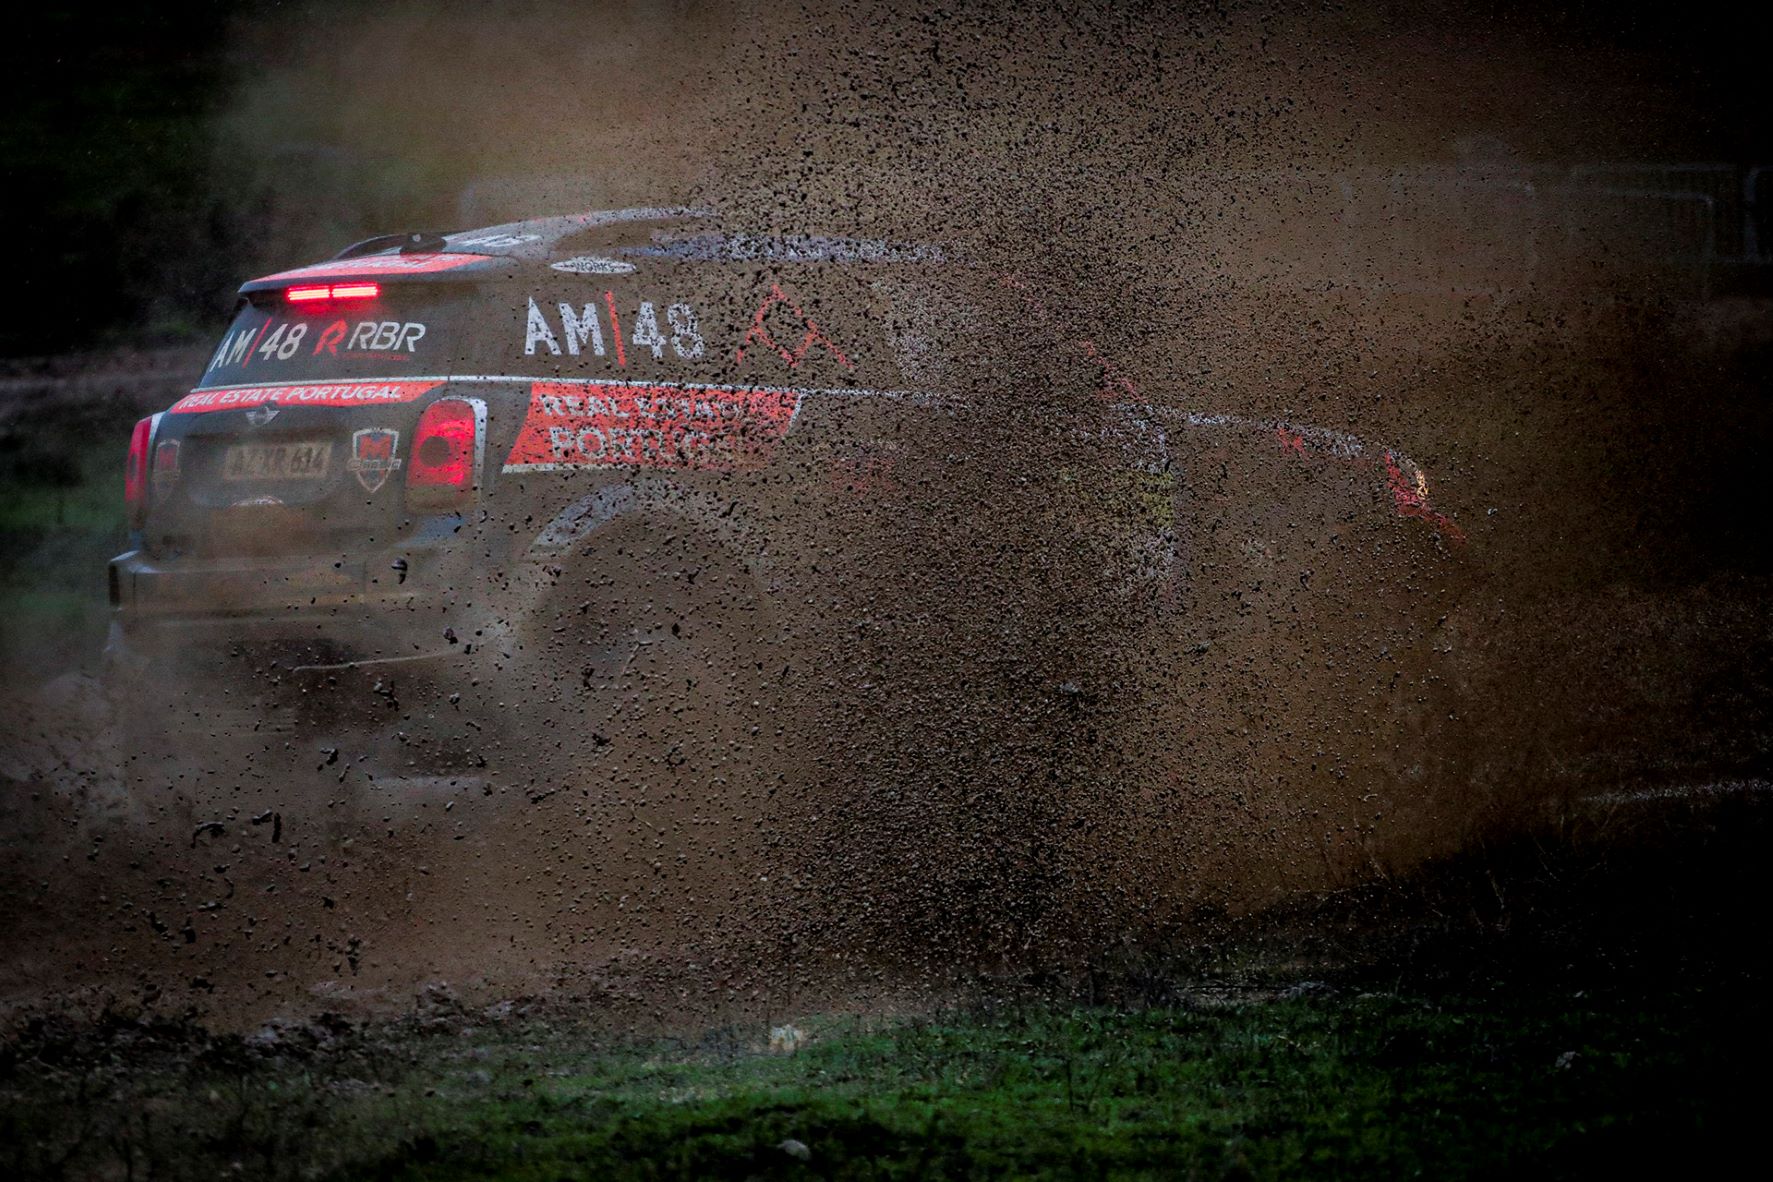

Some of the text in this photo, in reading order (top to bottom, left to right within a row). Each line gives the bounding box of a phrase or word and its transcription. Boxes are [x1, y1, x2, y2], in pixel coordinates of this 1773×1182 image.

[347, 321, 426, 353] RBR
[178, 384, 402, 410] REAL ESTATE PORTUGAL
[540, 395, 630, 418] REAL
[289, 446, 324, 474] 614
